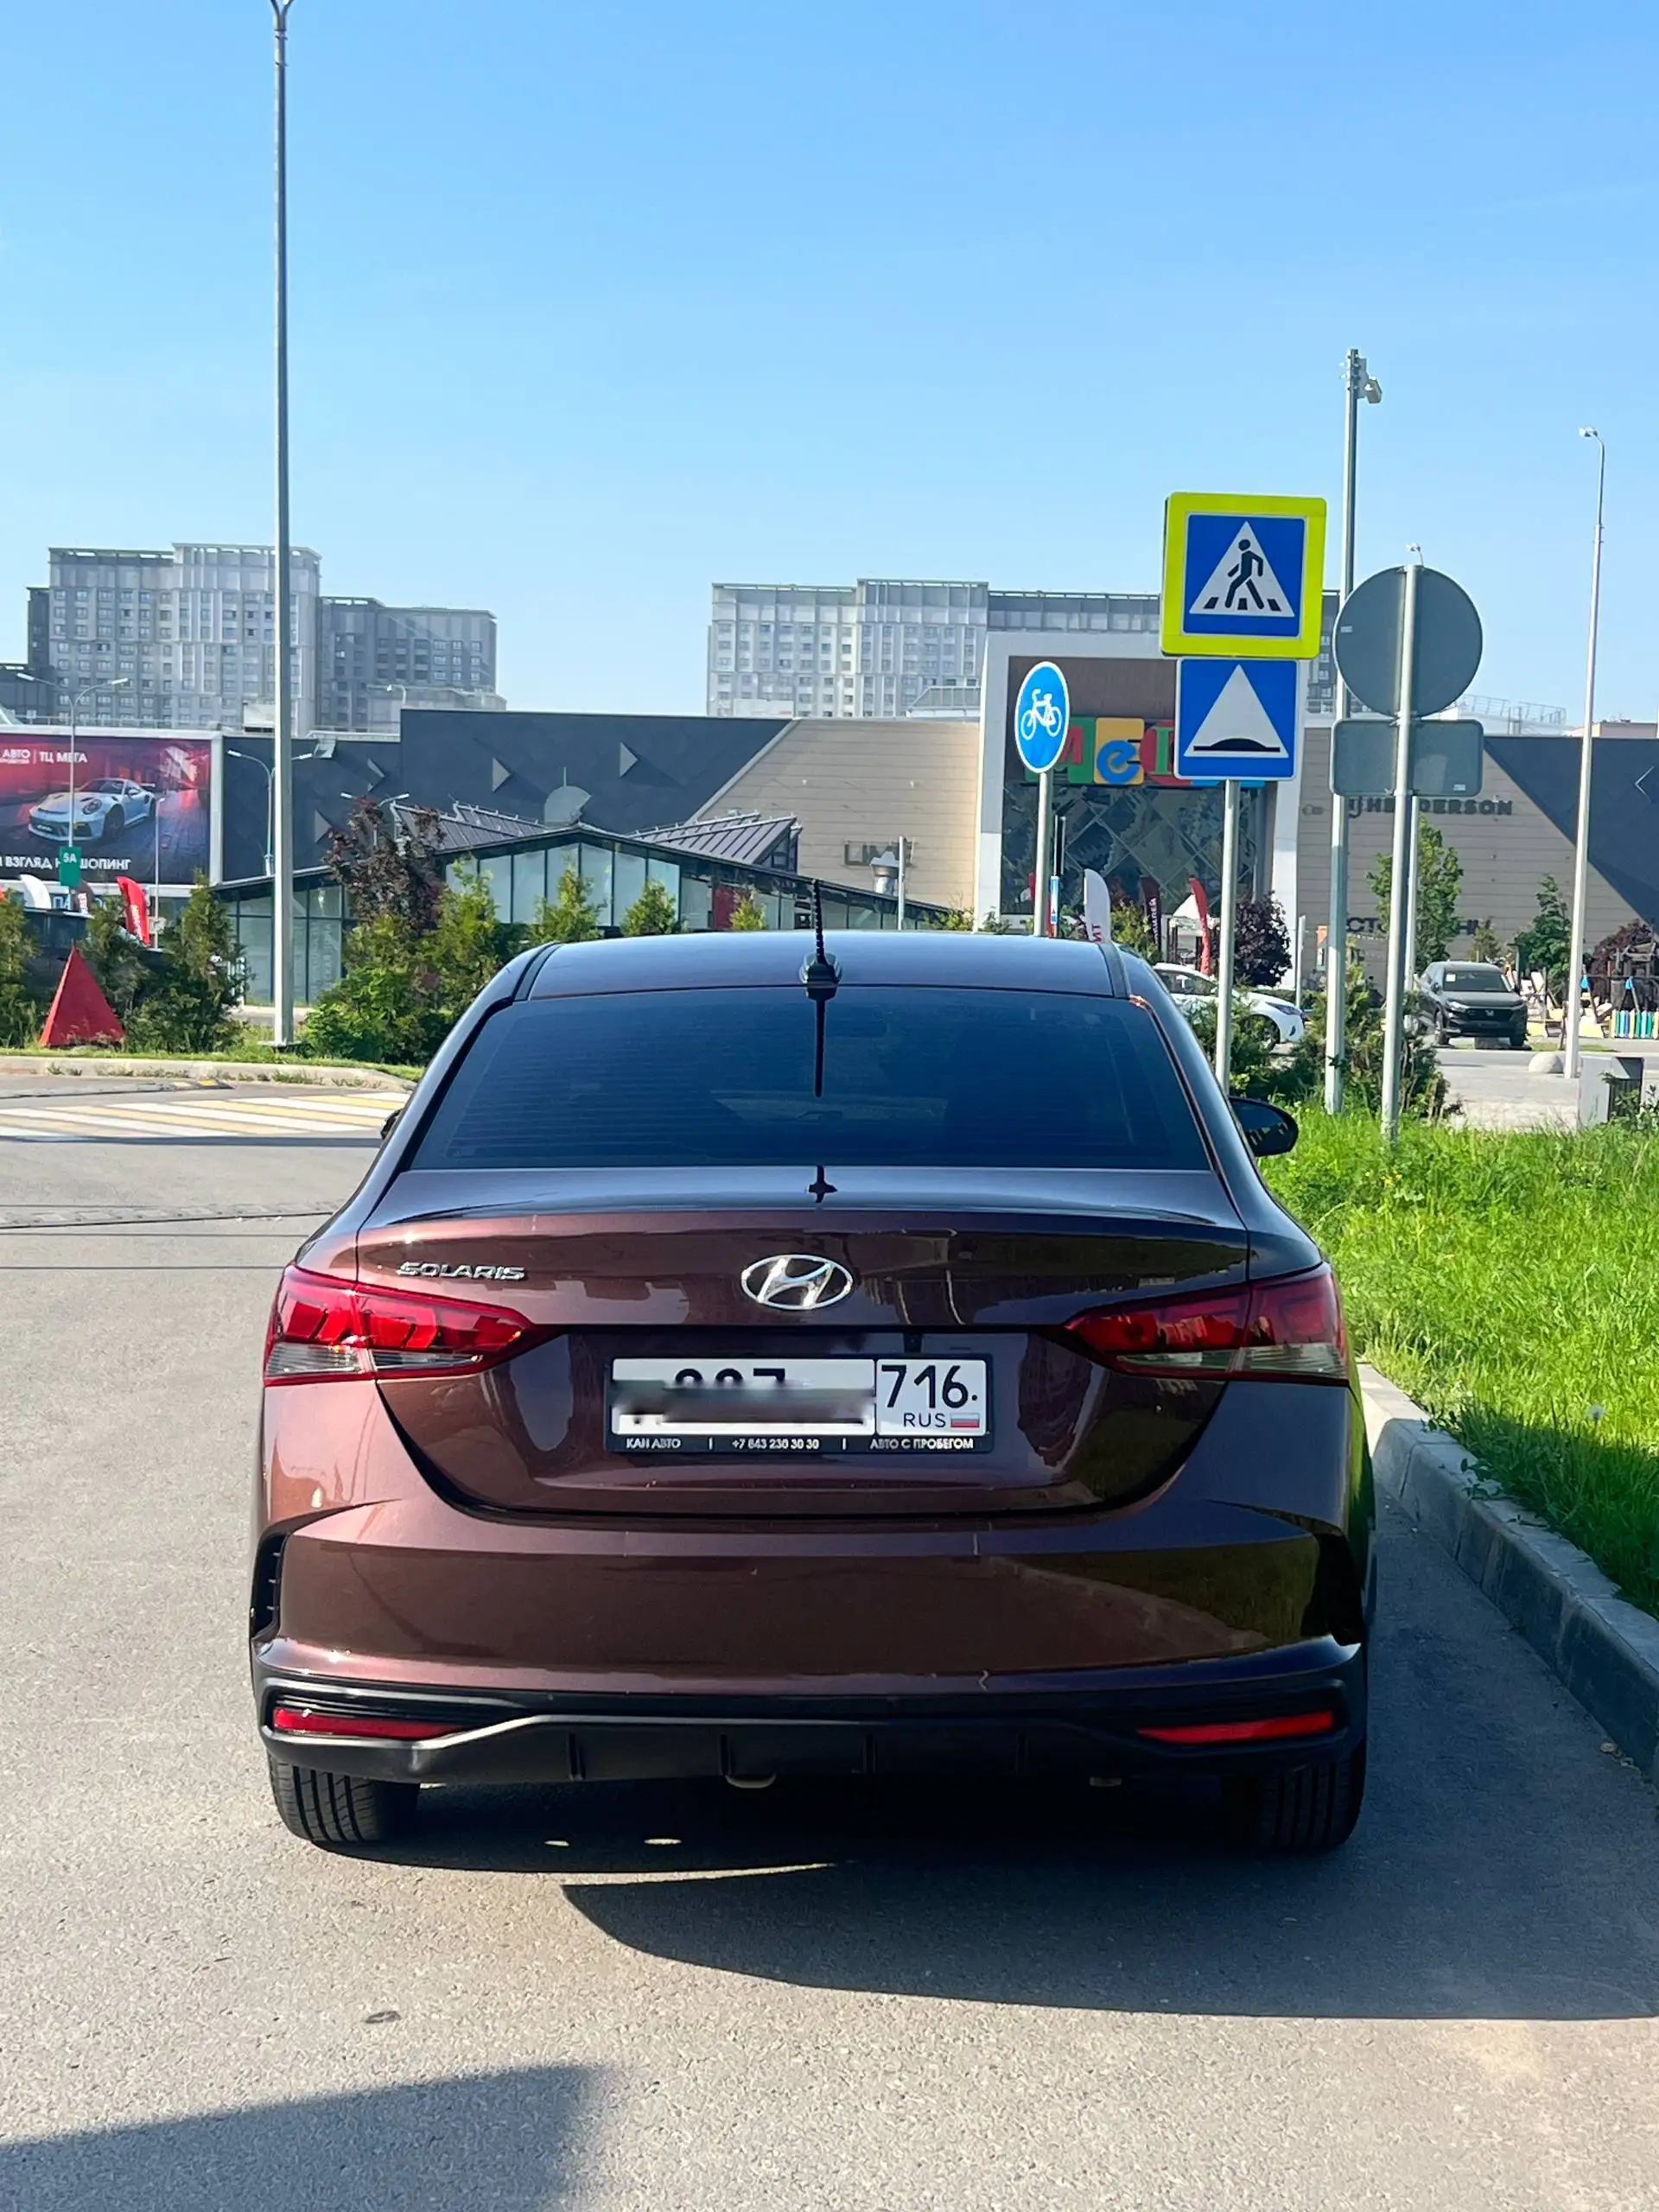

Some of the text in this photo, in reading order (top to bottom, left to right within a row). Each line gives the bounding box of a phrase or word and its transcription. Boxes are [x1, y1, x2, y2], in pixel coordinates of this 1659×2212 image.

[3, 749, 30, 759] АВТО
[40, 752, 54, 764] ТЦ
[1367, 797, 1513, 816] HEDERSON
[5, 855, 53, 869] ВЗГЛЯД
[396, 1261, 525, 1281] SOLARIS
[903, 1412, 946, 1428] RUS
[626, 1438, 650, 1450] КАН
[652, 1438, 682, 1450] АВТО
[732, 1438, 746, 1450] +7
[769, 1438, 789, 1450] 230
[791, 1438, 804, 1450] 30
[806, 1438, 820, 1450] 30
[869, 1438, 899, 1450] АВТО
[901, 1438, 911, 1450] С
[913, 1438, 974, 1450] ПРОБЕГОМ
